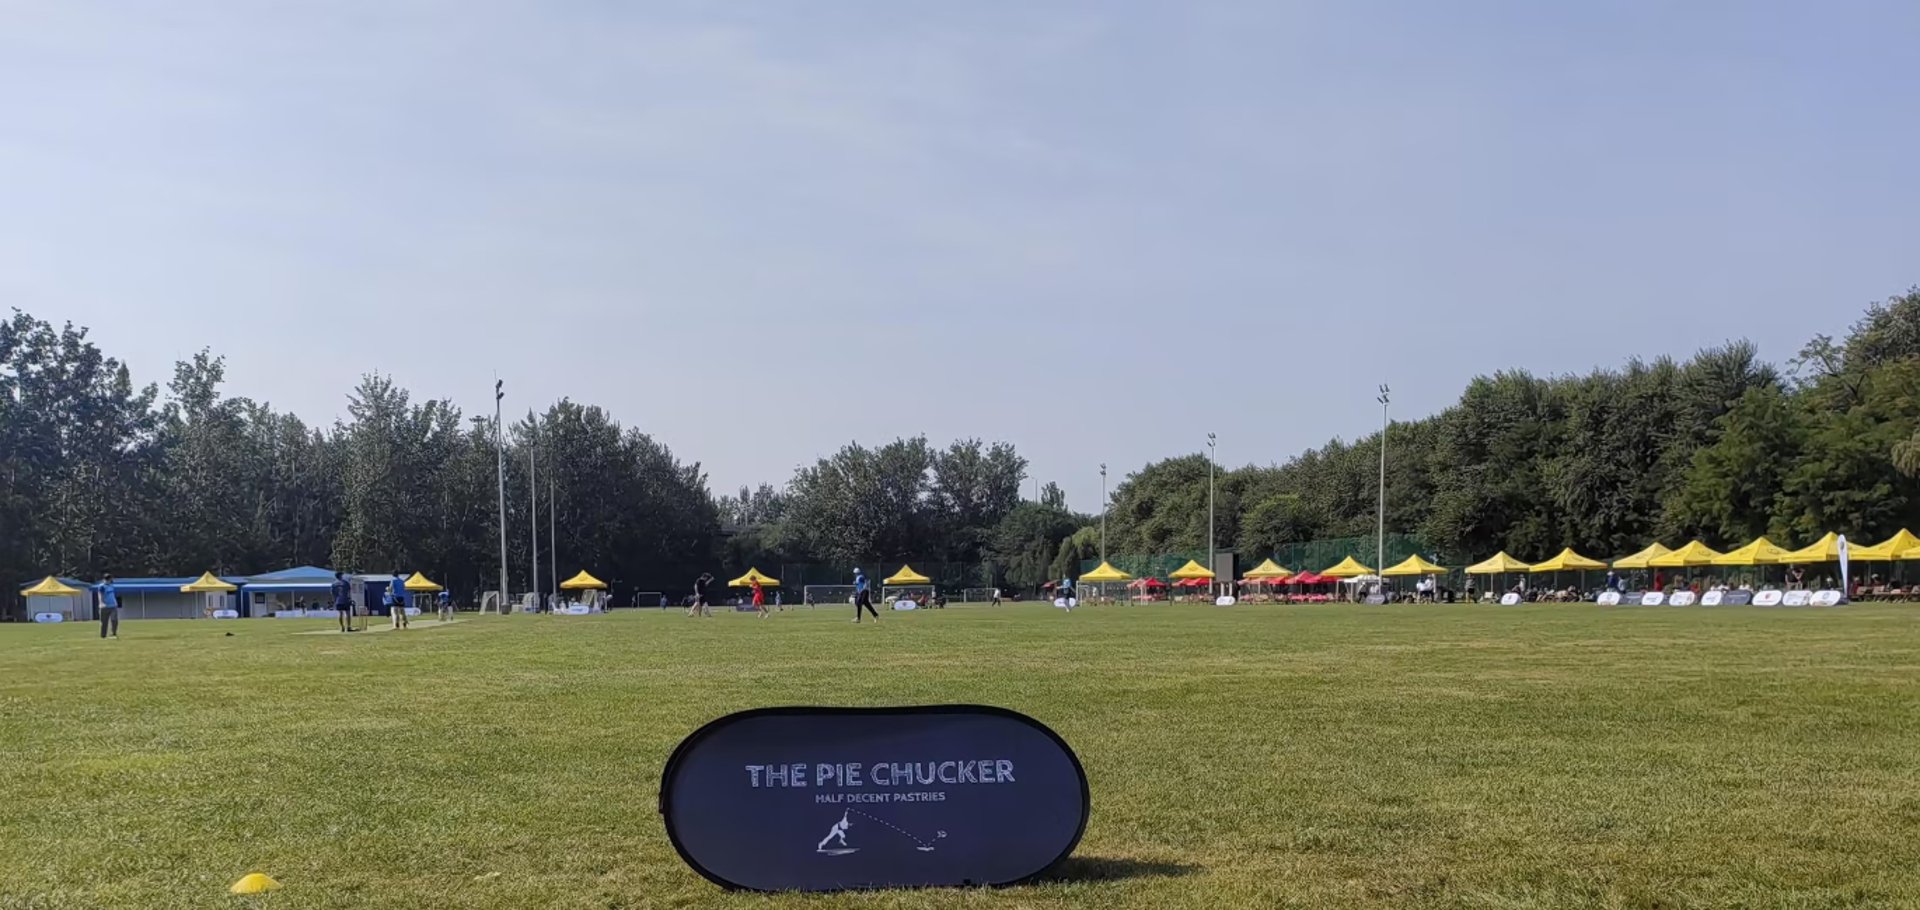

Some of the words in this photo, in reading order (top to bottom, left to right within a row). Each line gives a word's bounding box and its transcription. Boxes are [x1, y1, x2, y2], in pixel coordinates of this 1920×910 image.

[745, 763, 807, 788] THE
[816, 762, 863, 787] PIE
[870, 759, 1016, 786] CHUCKER
[815, 793, 844, 803] HALF
[847, 793, 890, 803] DECENT
[893, 791, 946, 802] PASTRIES
